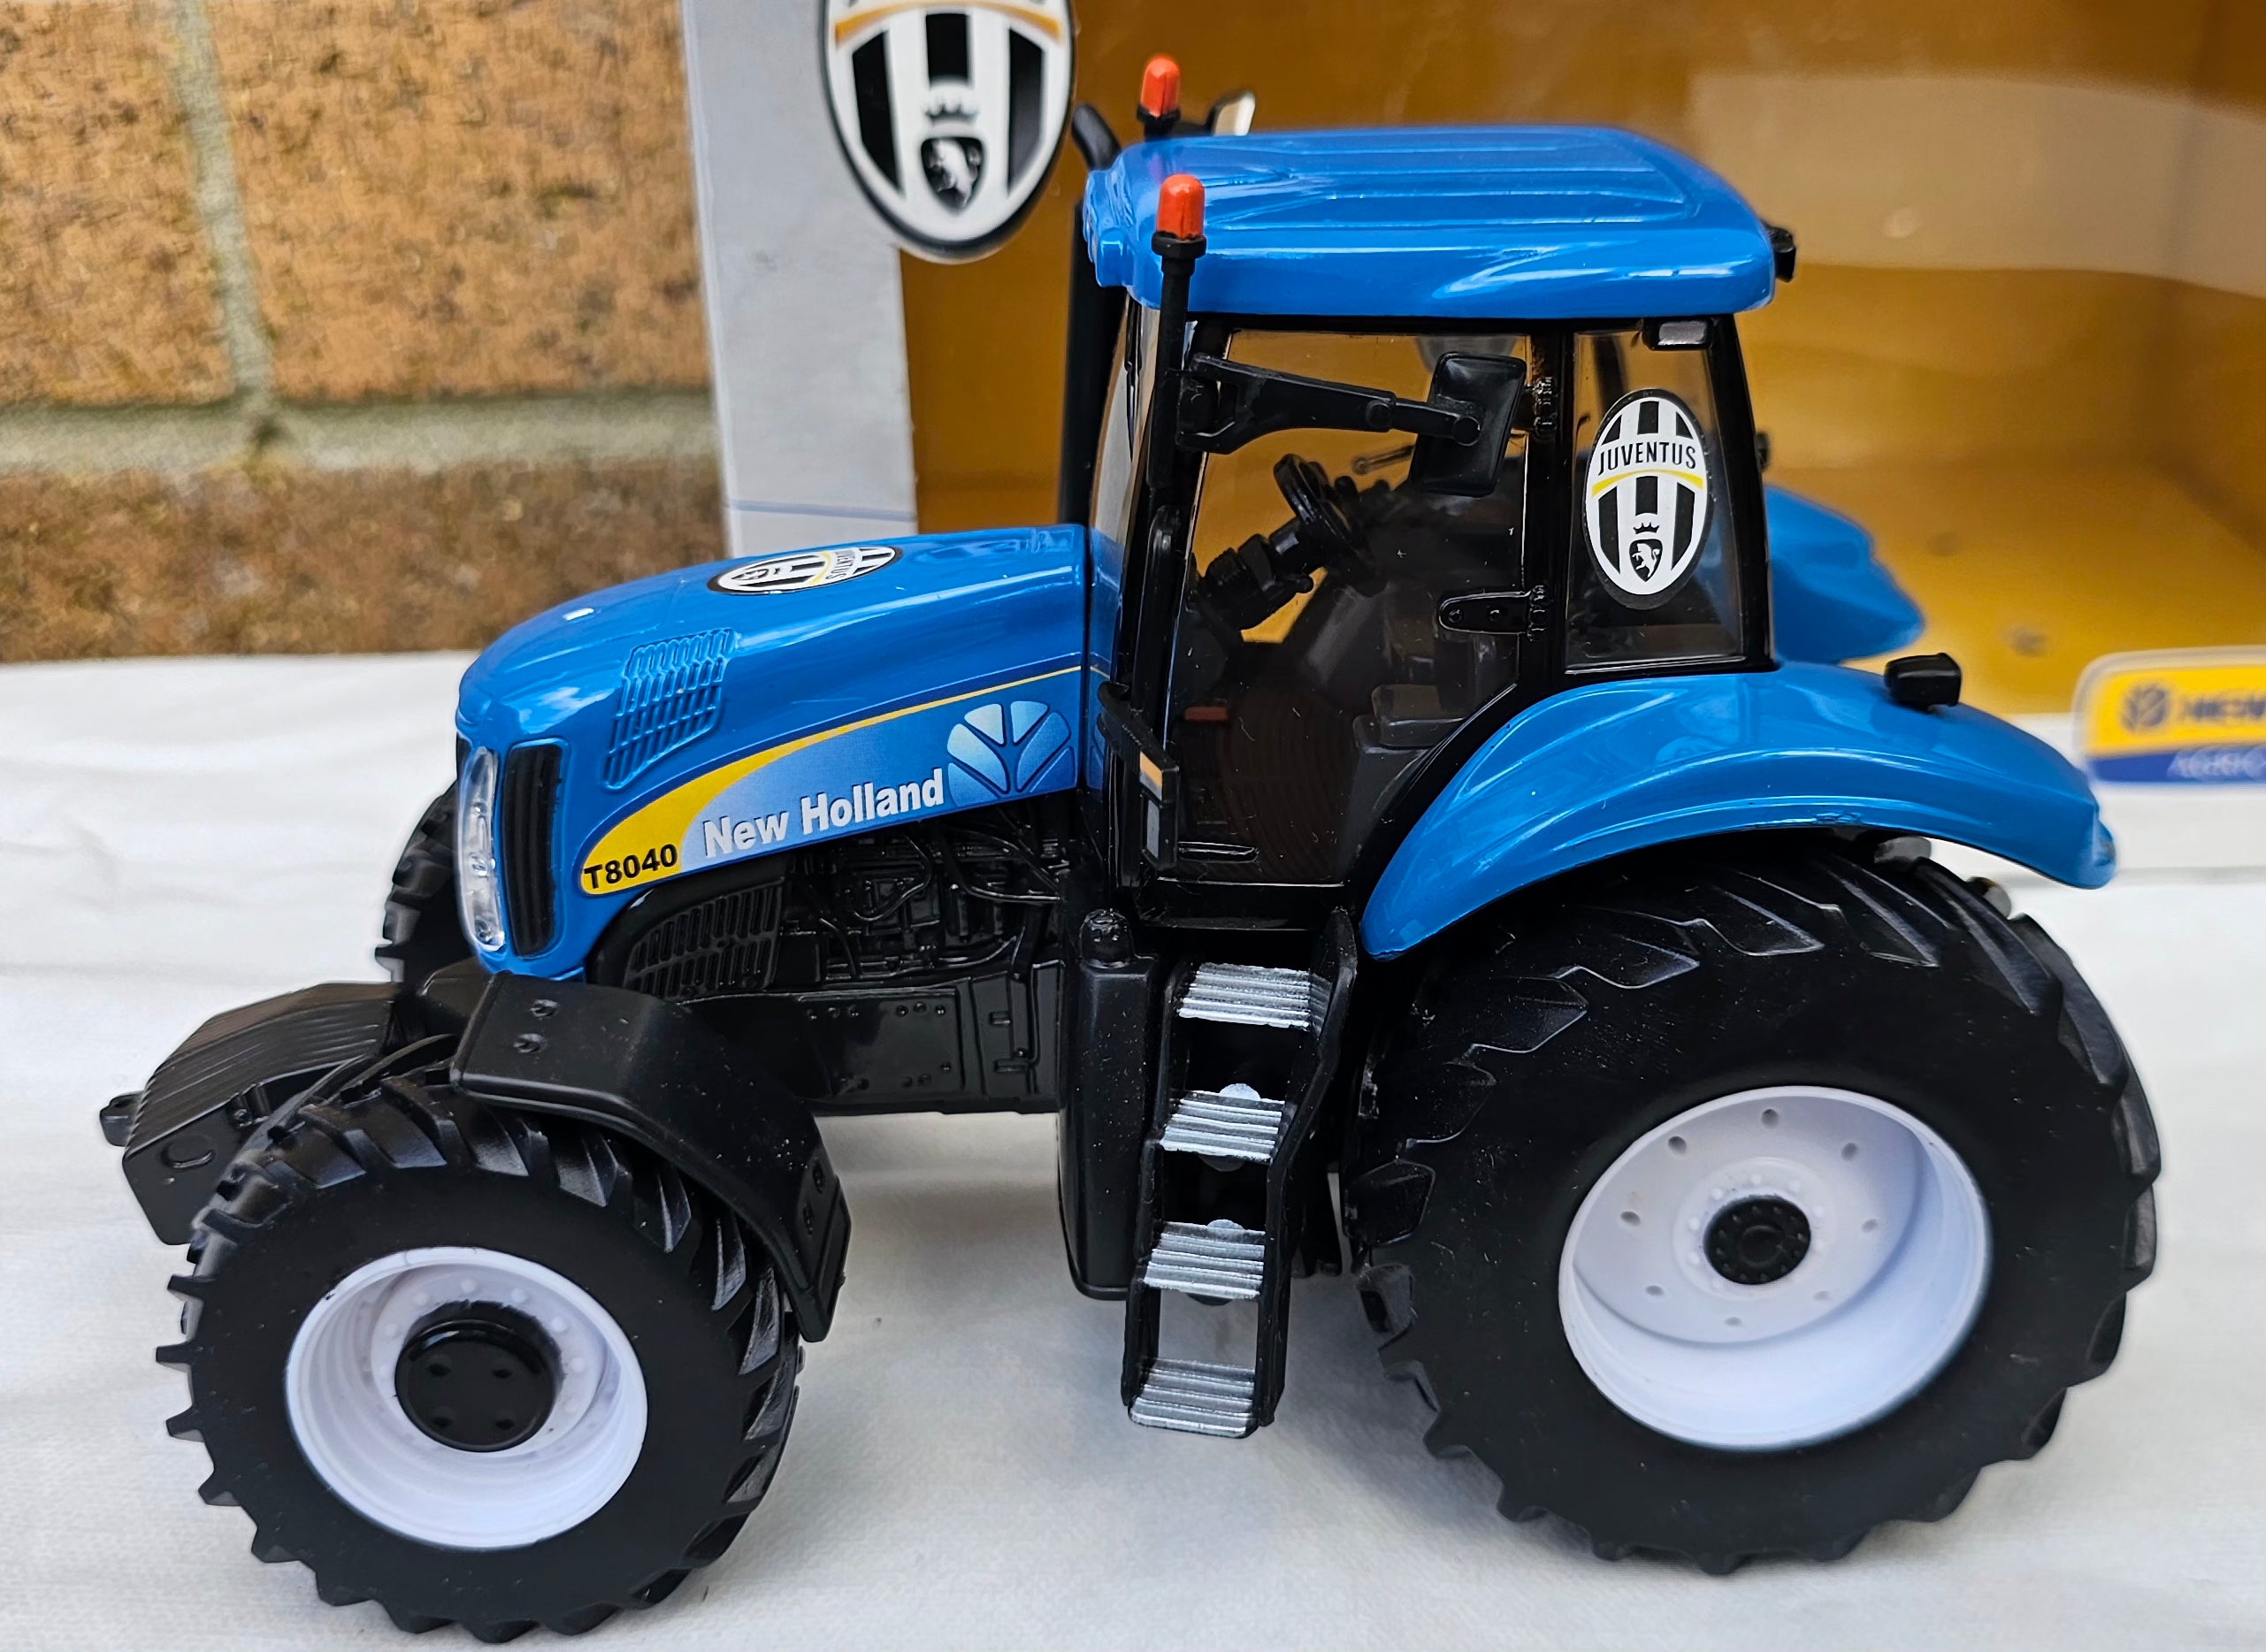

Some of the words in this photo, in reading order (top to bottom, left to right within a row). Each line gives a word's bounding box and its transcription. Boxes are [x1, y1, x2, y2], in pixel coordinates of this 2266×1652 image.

[1597, 441, 1696, 476] JUVENTUS
[702, 810, 790, 859] New
[800, 768, 945, 835] Holland
[584, 843, 679, 890] T8040
